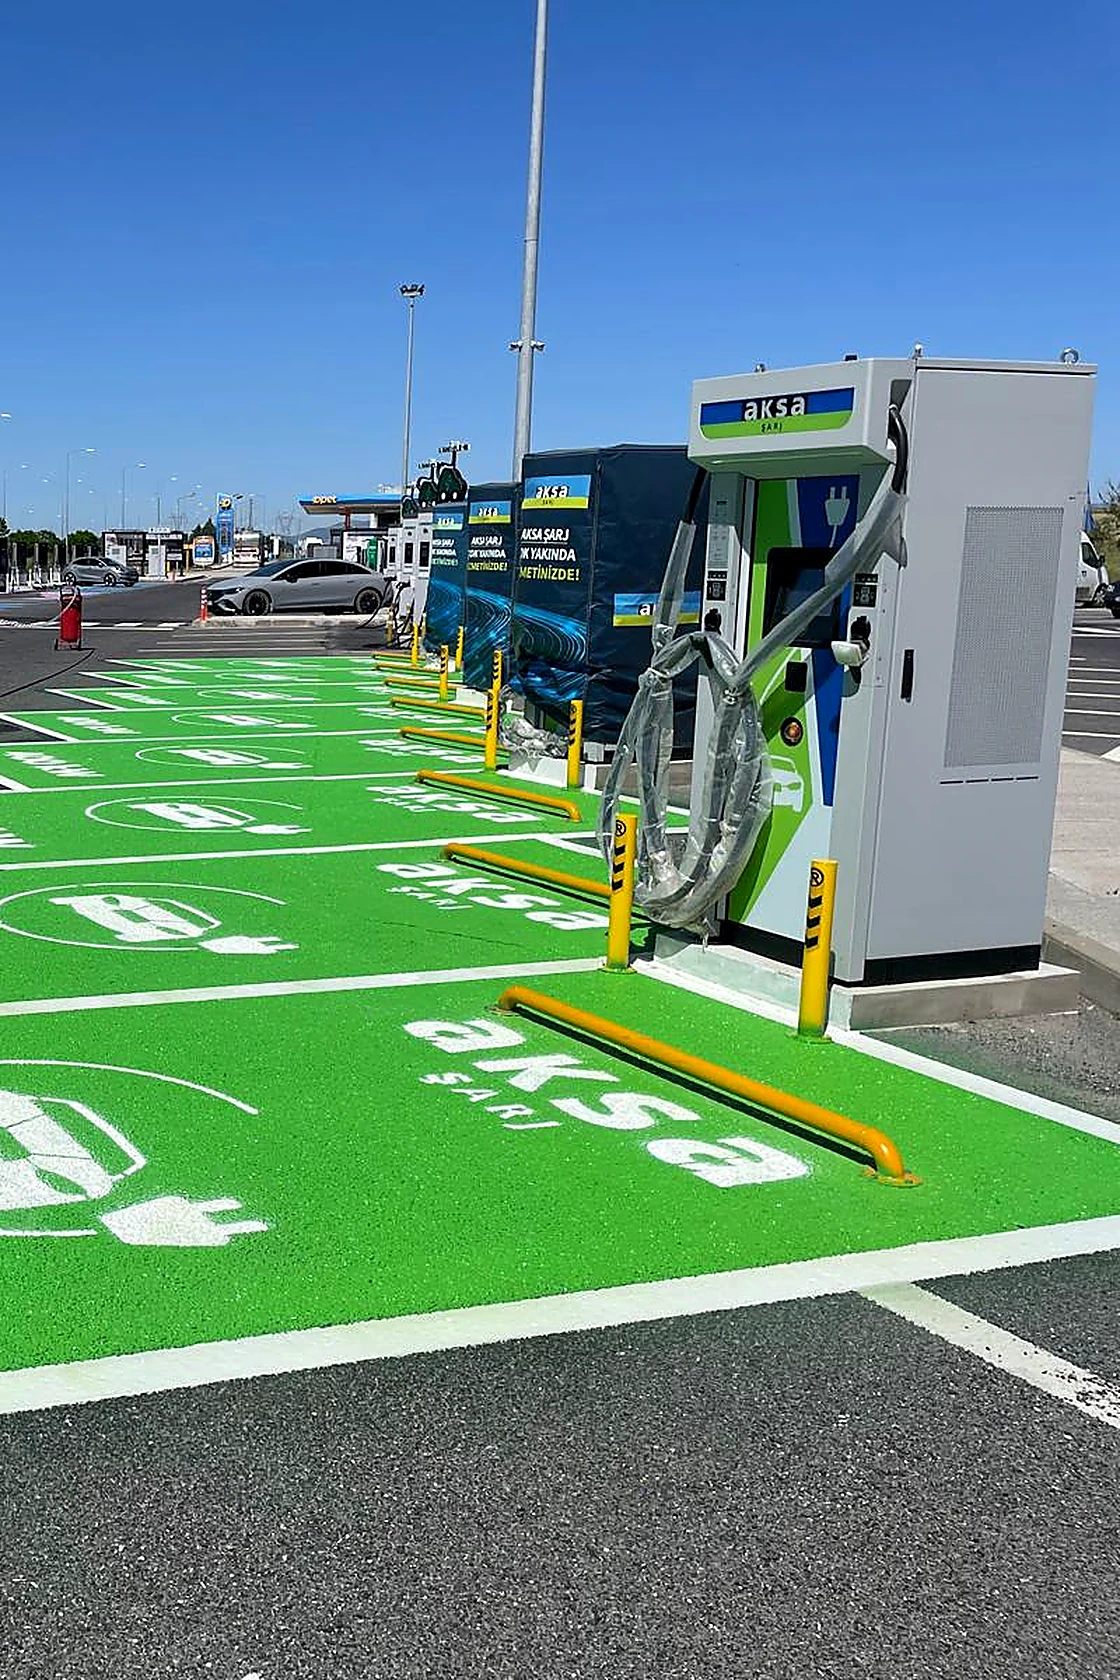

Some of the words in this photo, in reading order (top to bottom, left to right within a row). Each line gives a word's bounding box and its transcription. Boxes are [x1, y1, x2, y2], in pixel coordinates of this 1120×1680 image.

[744, 396, 806, 421] aksa
[535, 485, 570, 499] aksa
[521, 528, 543, 541] AKSA
[543, 528, 570, 543] ŞARJ
[530, 547, 576, 562] YAKINDA
[402, 1018, 809, 1188] aksa
